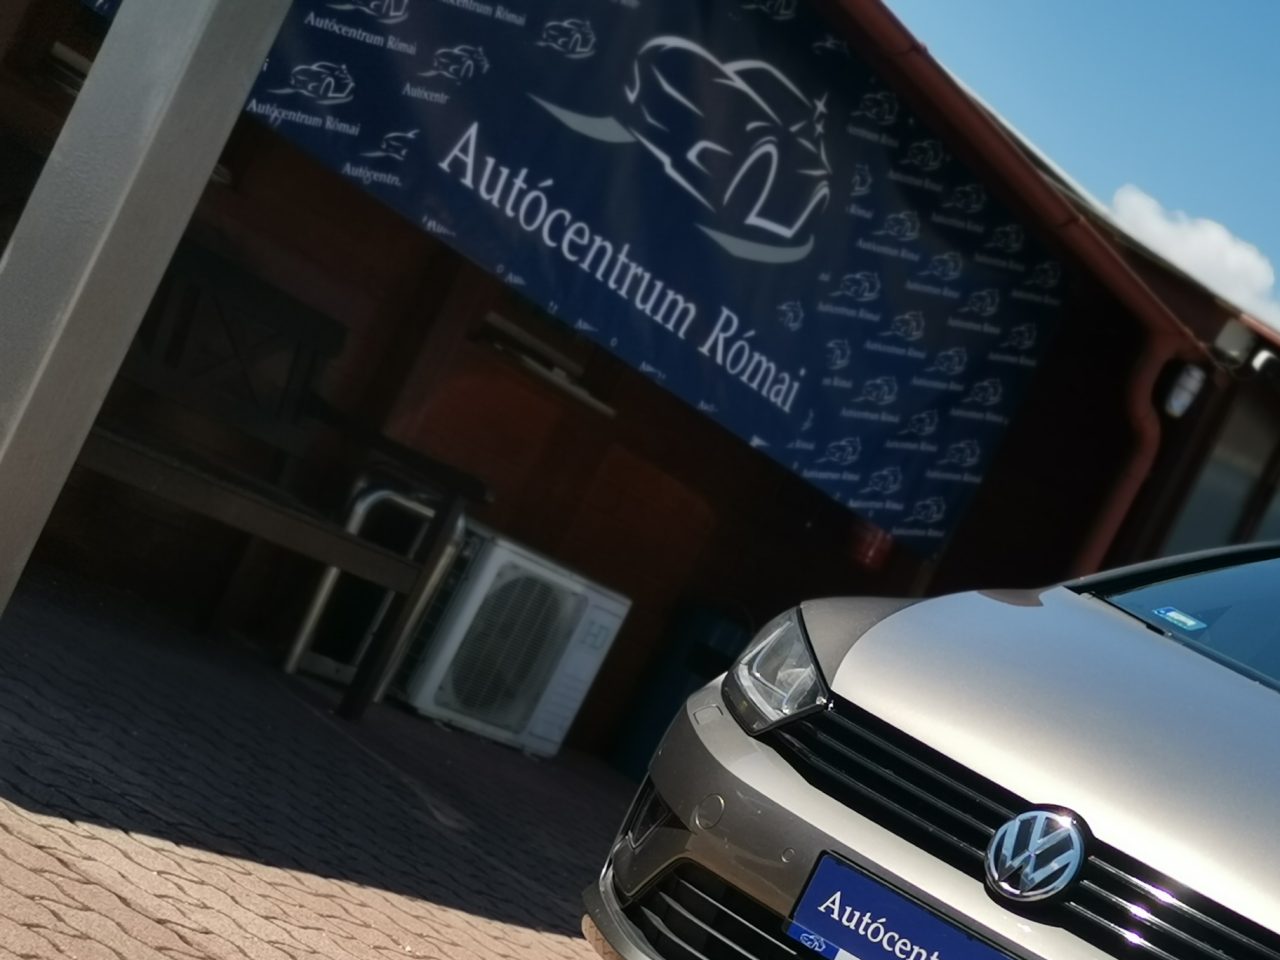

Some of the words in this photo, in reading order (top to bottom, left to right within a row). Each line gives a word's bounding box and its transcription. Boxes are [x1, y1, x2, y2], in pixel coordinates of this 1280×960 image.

[304, 11, 384, 48] Autócentrum
[386, 34, 417, 56] Római
[324, 114, 360, 137] Római
[438, 121, 697, 340] Autócentrum
[698, 306, 807, 414] Római
